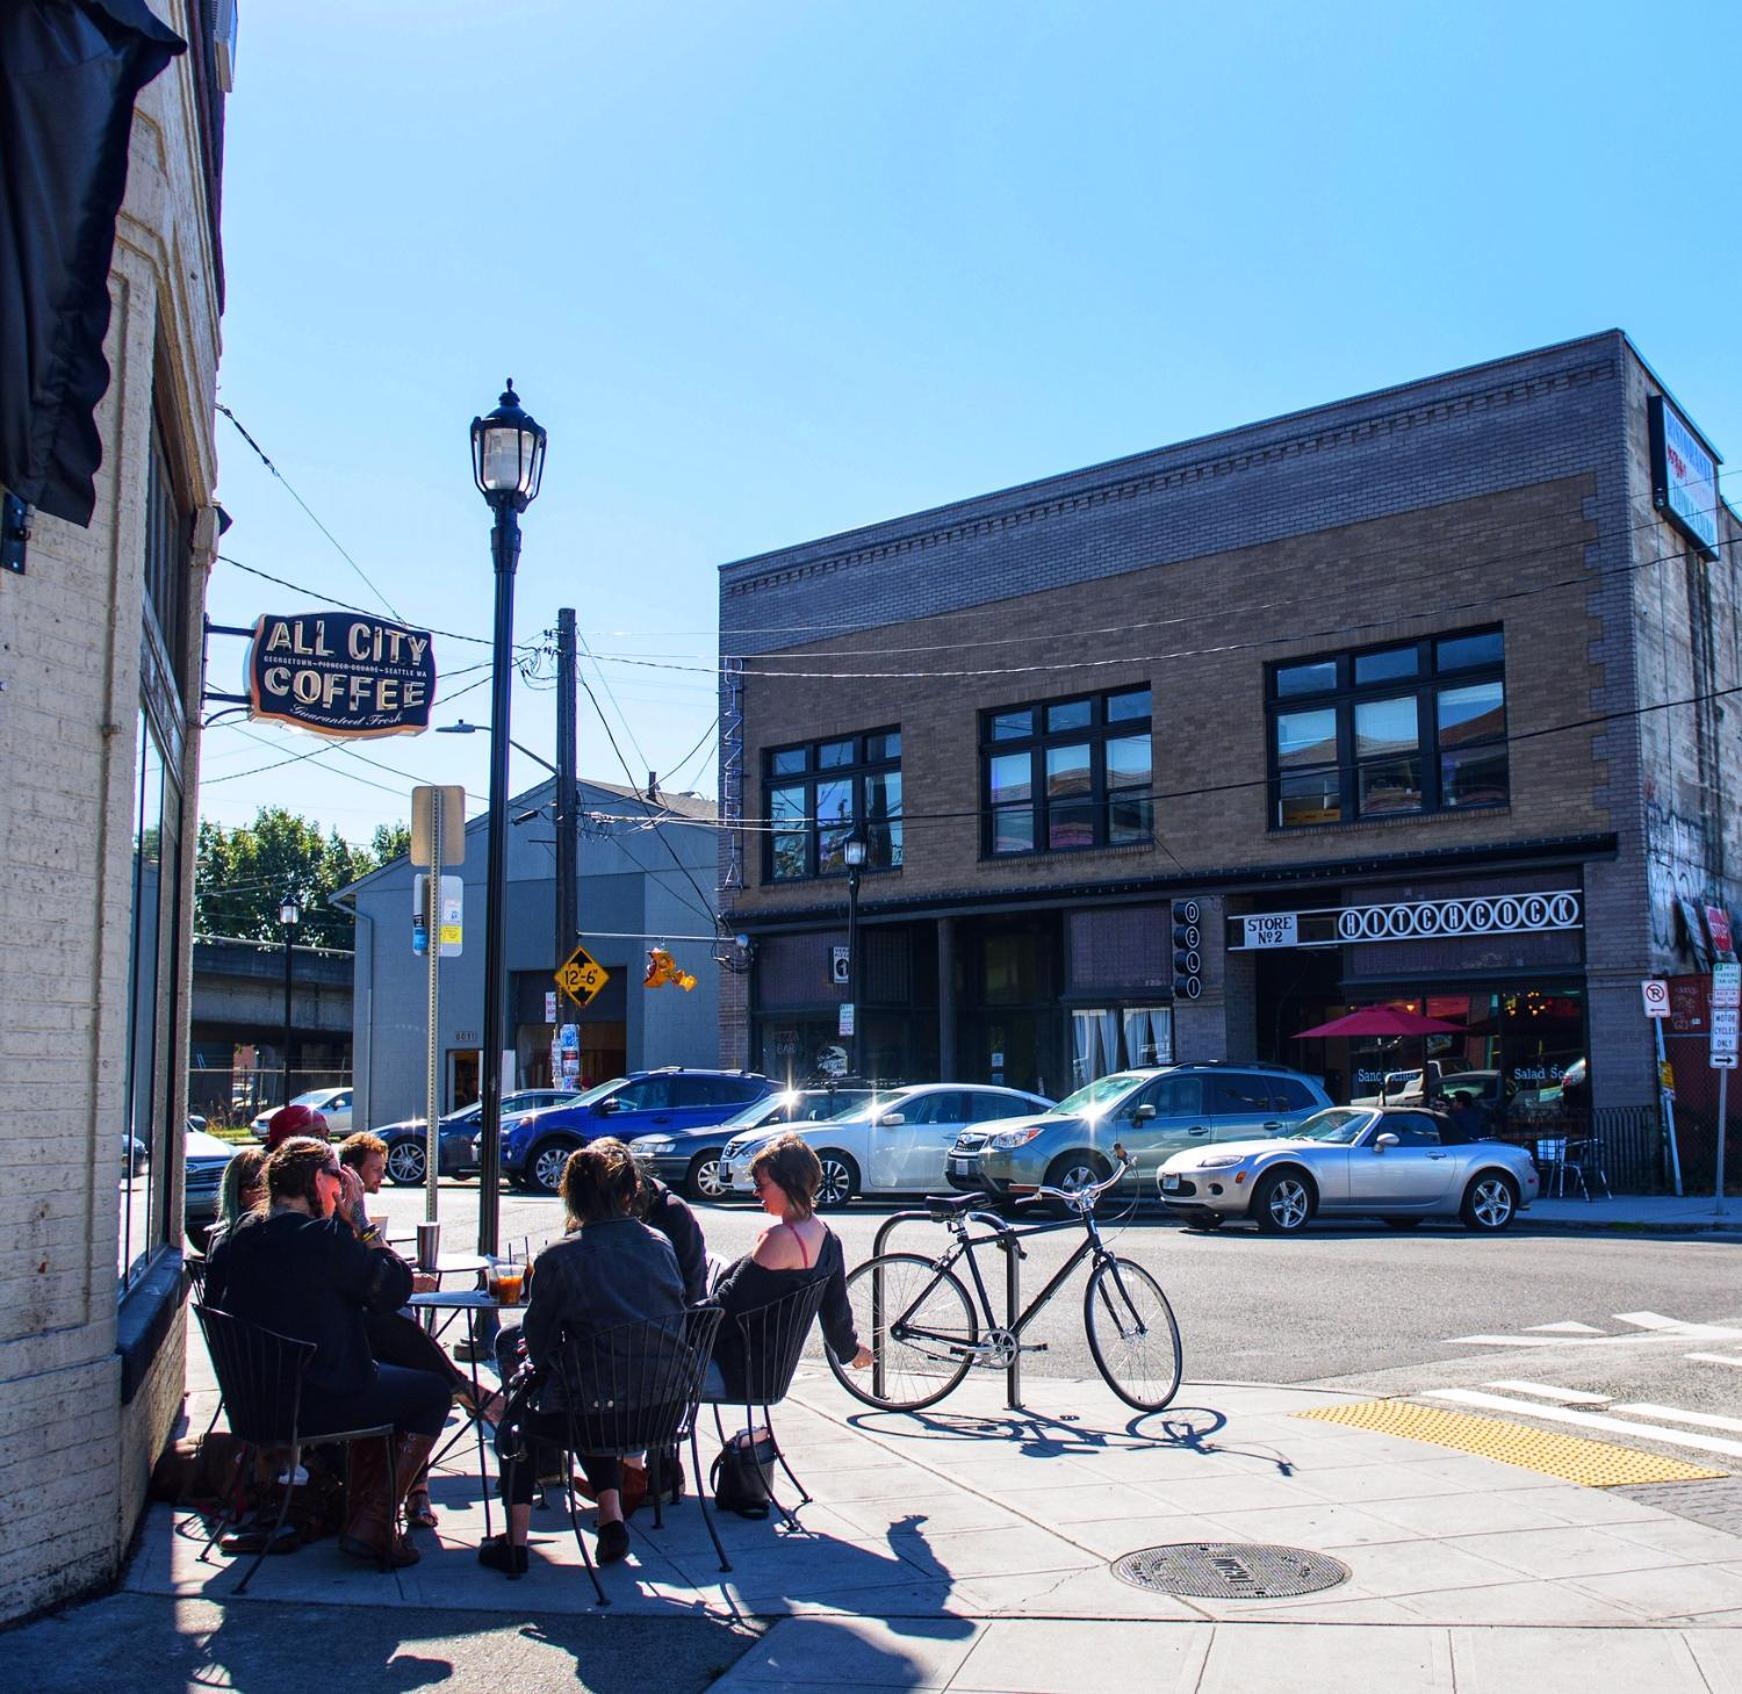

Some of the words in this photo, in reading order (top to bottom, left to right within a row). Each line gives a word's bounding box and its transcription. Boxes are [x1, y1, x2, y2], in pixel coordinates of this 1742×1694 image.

[266, 620, 334, 657] ALL
[348, 623, 427, 666] CITY
[264, 666, 426, 711] COFFEE
[290, 704, 366, 726] Guaranteed
[366, 709, 402, 726] Fresh
[1248, 916, 1293, 932] STORE
[1342, 896, 1575, 937] HITCHCOCK
[1187, 904, 1199, 996] DELI
[1274, 930, 1284, 943] 2
[1514, 1066, 1546, 1081] Salad
